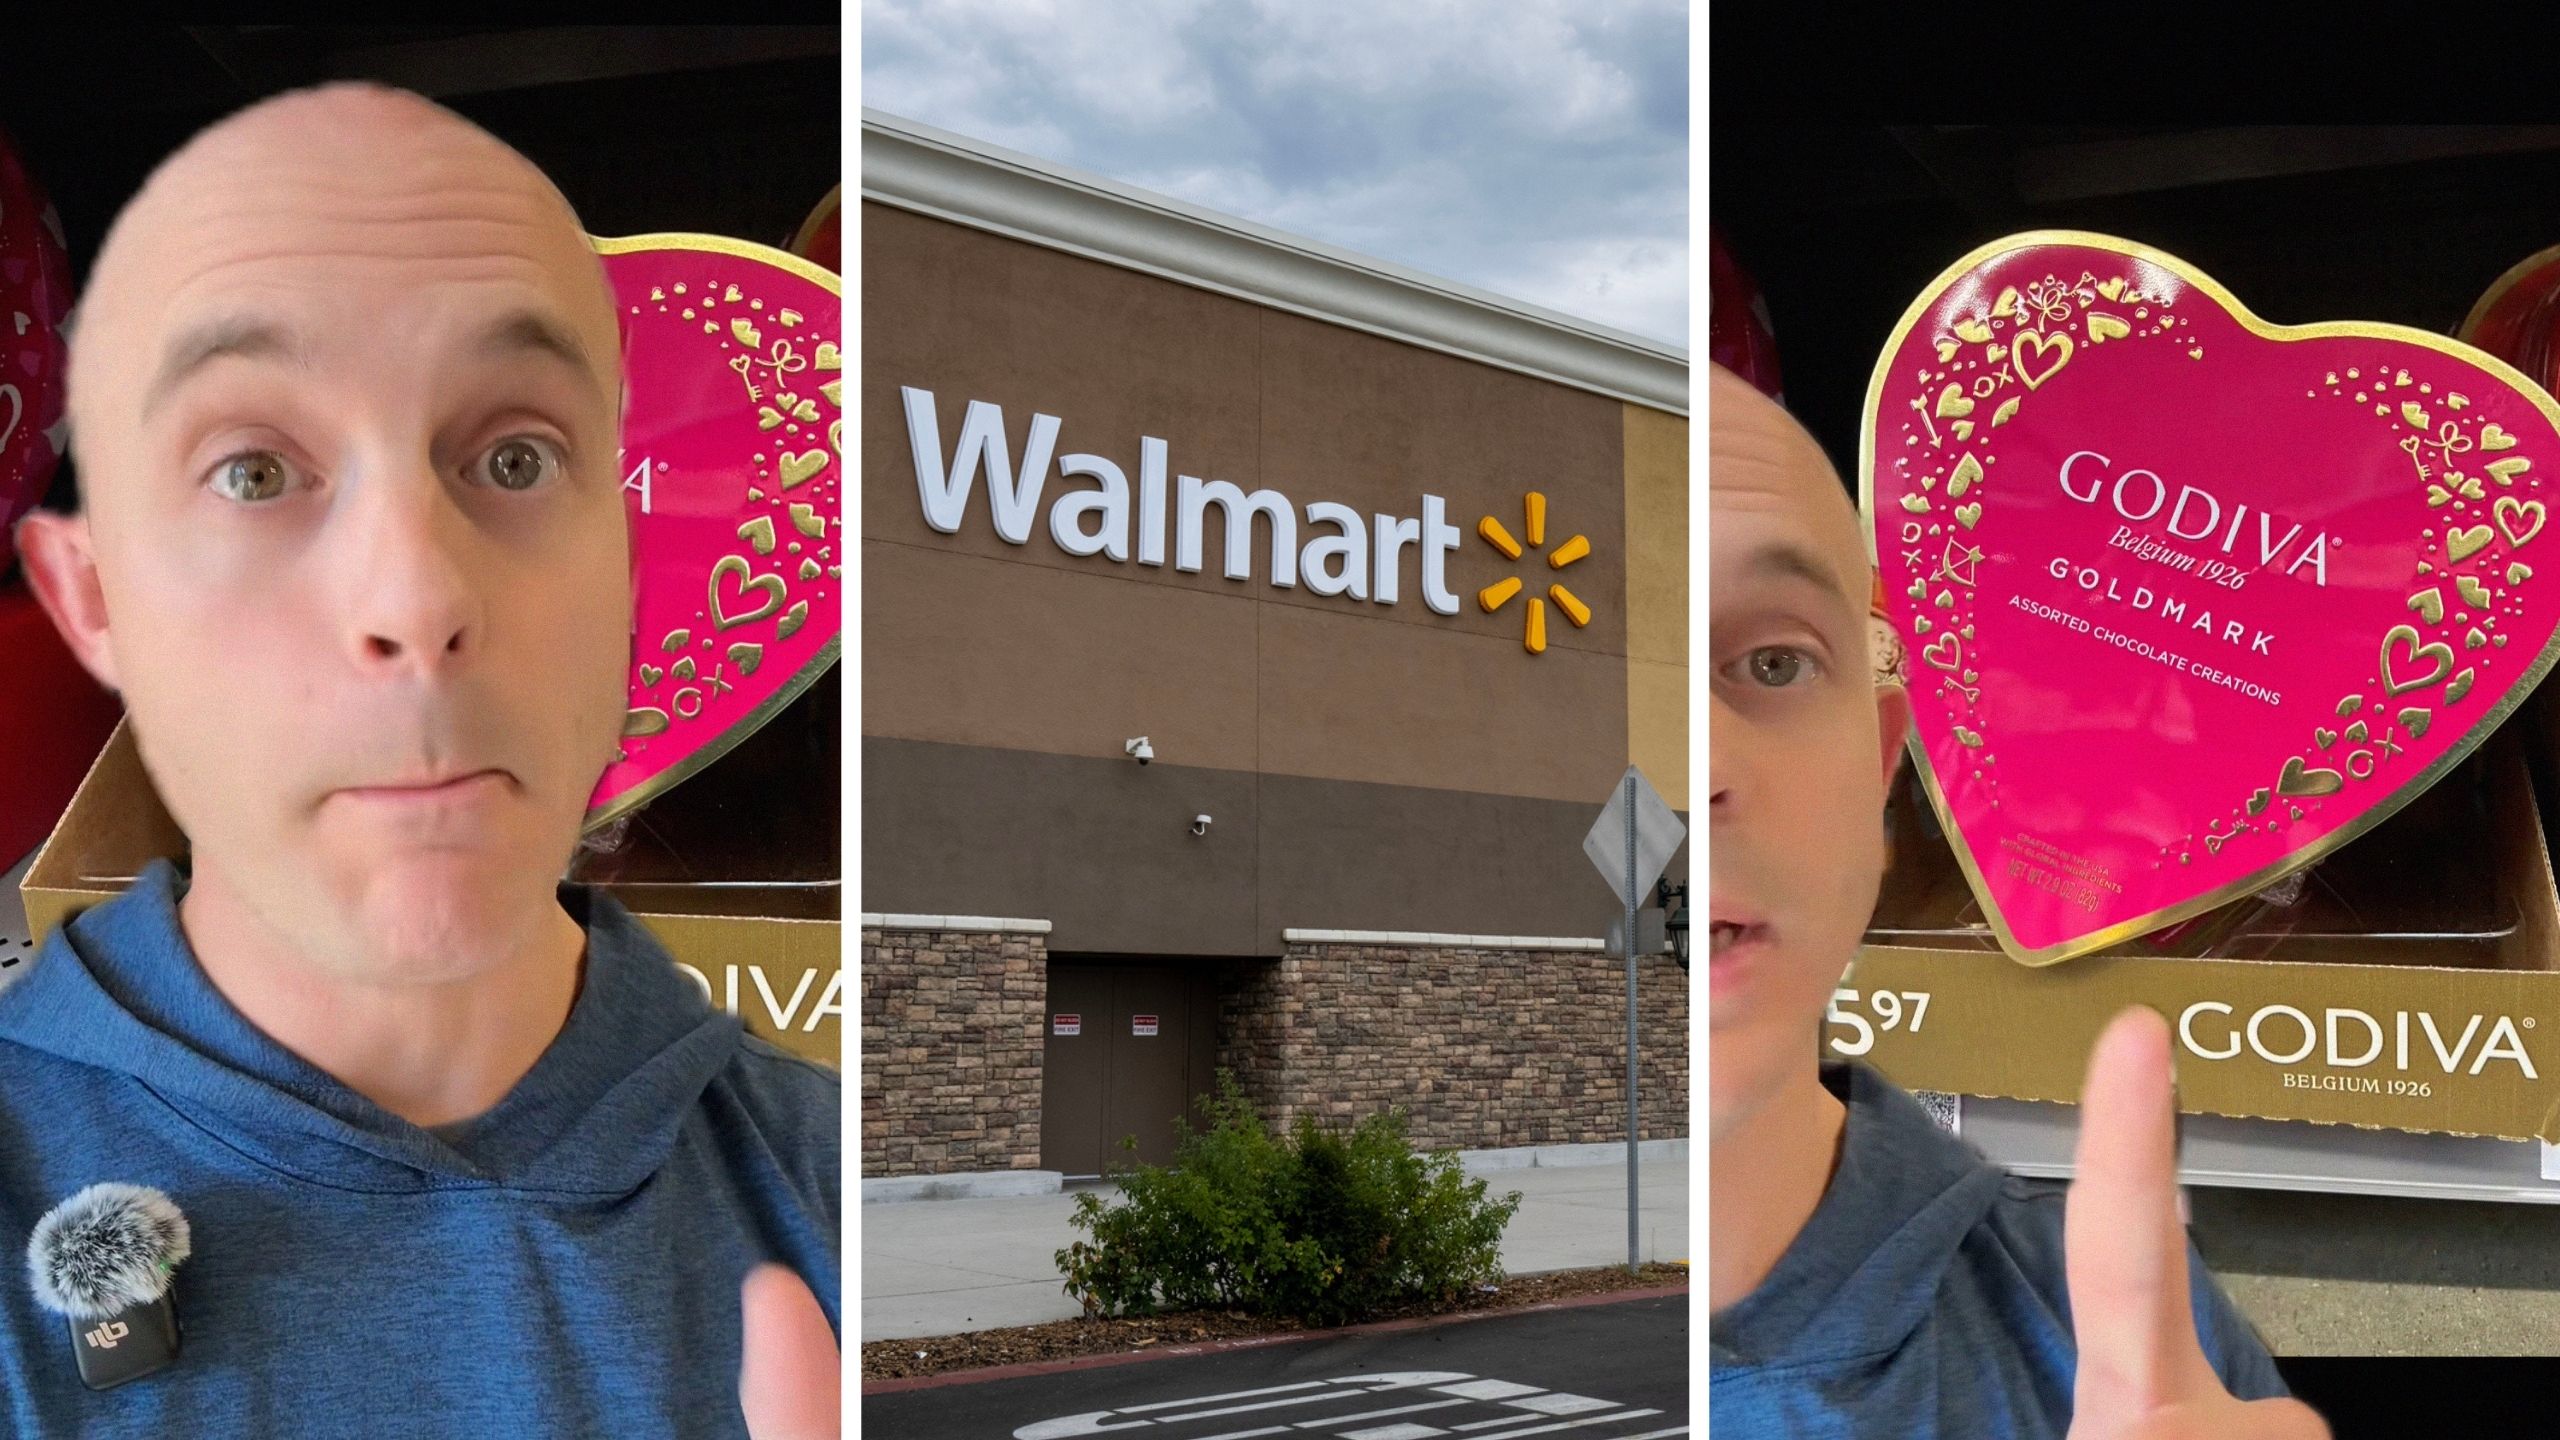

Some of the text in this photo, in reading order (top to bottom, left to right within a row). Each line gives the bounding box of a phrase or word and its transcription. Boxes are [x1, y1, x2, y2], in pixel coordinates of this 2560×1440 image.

[900, 384, 1461, 616] Walmart
[2108, 524, 2250, 591] Belgium 1926
[2049, 557, 2276, 656] GOLDMARK
[2008, 594, 2282, 706] ASSORTED CHOCOLATE CREATIONS
[2063, 862, 2123, 894] INGREDIENTS
[2091, 863, 2109, 876] USA
[2283, 1073, 2432, 1098] BELGIUM 1926
